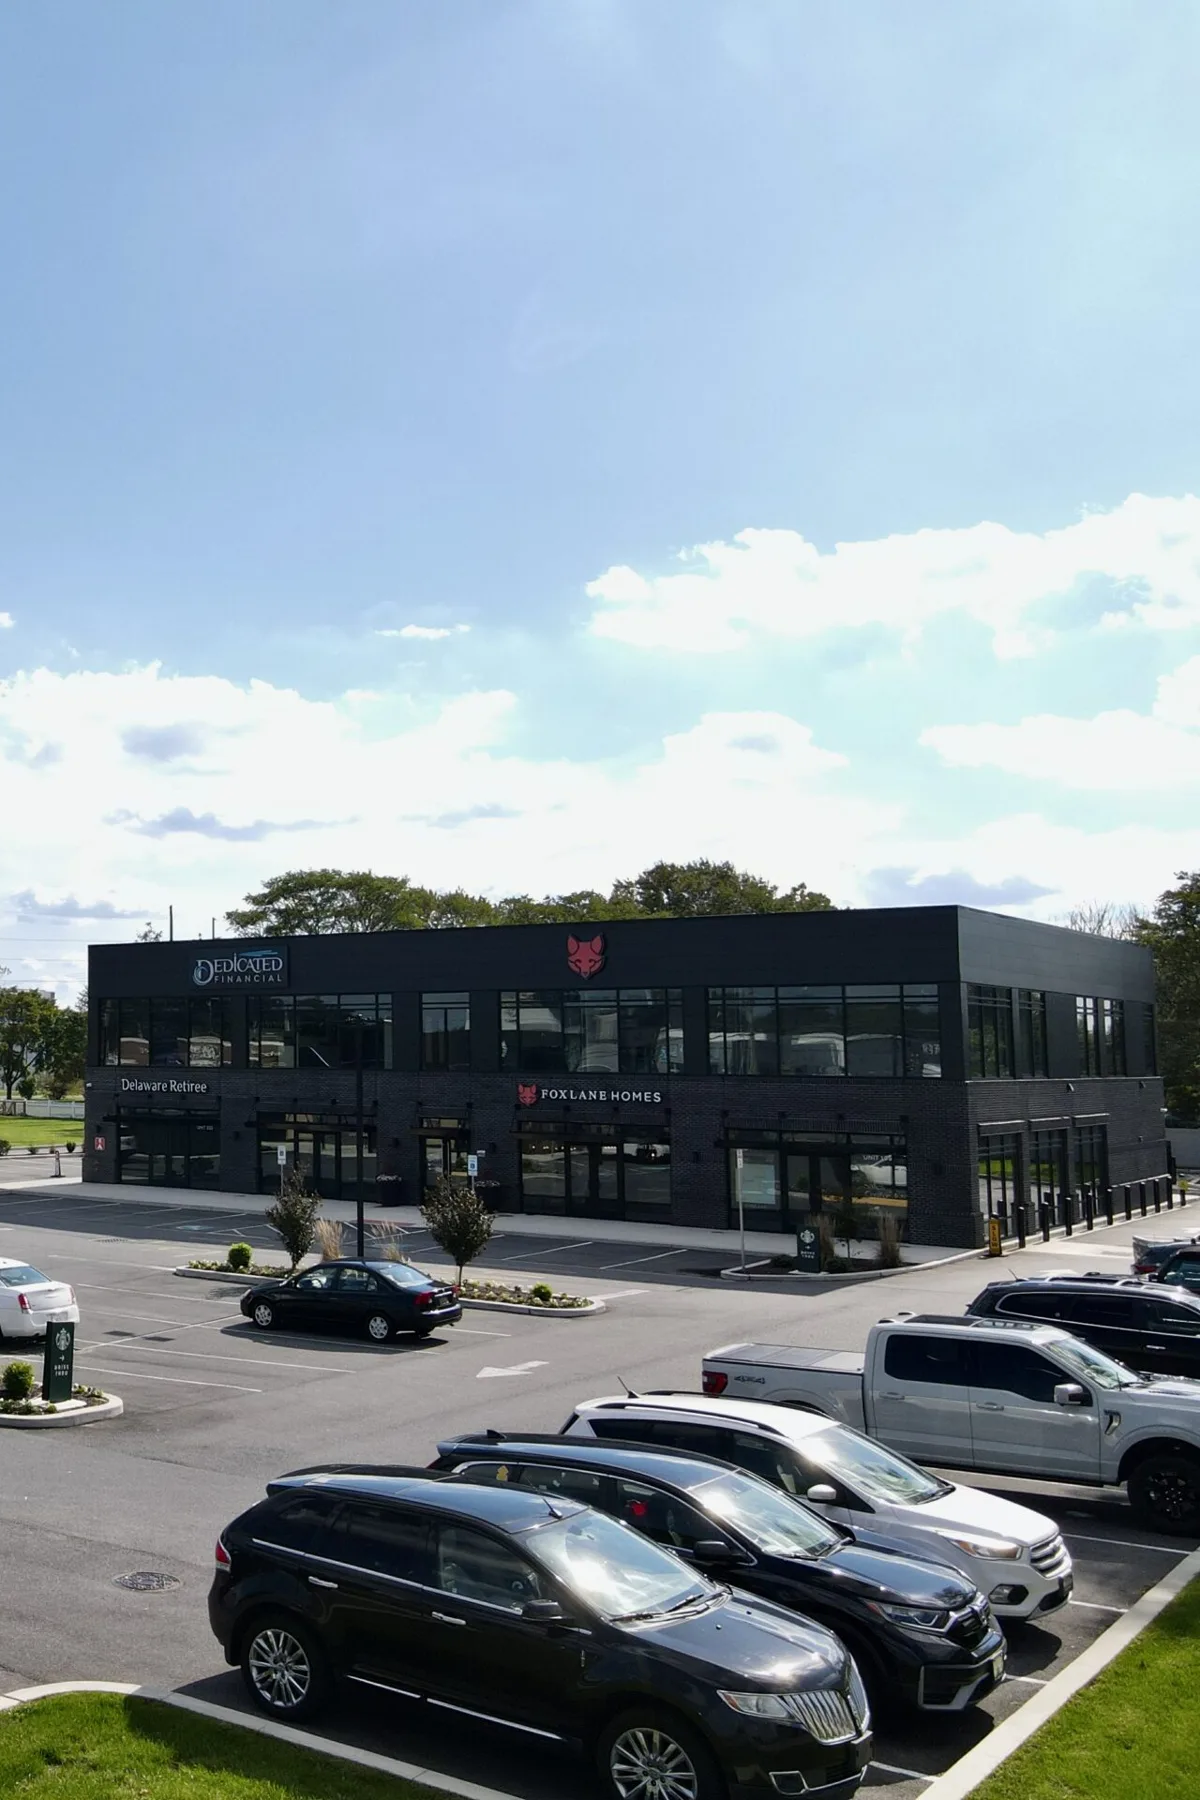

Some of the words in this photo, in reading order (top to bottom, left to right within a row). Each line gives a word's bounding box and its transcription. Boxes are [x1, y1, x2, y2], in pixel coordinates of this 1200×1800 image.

[193, 952, 283, 985] DEDICATED
[214, 974, 282, 983] FINANCIAL
[121, 1078, 168, 1092] Delaware
[169, 1079, 207, 1093] Retiree
[611, 1091, 661, 1103] HOMES
